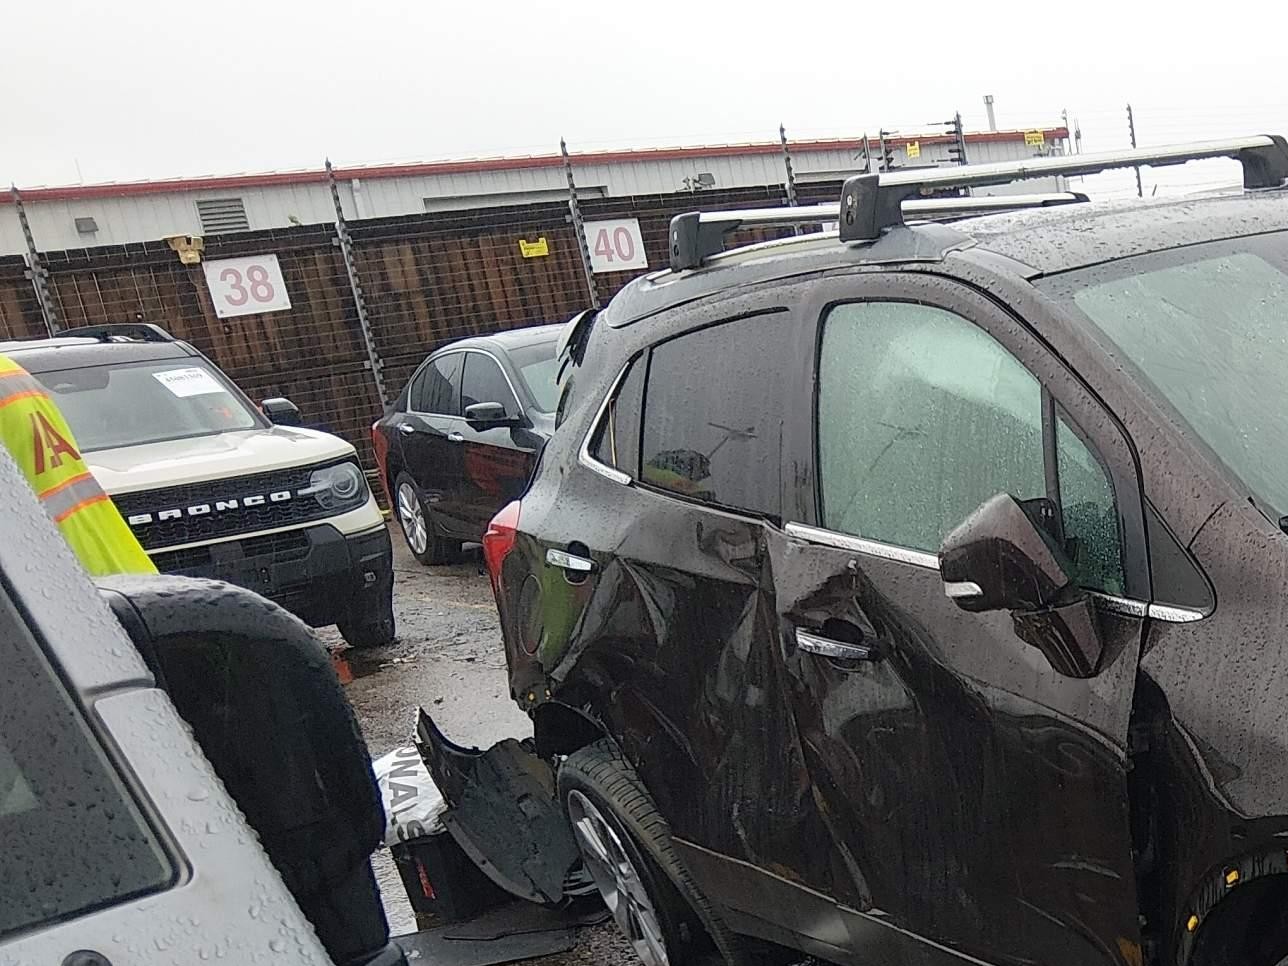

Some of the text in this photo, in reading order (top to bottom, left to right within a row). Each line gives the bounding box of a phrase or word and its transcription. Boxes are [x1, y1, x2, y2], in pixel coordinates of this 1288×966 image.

[594, 225, 635, 263] 40
[219, 264, 276, 307] 38
[128, 490, 292, 525] BRONCO
